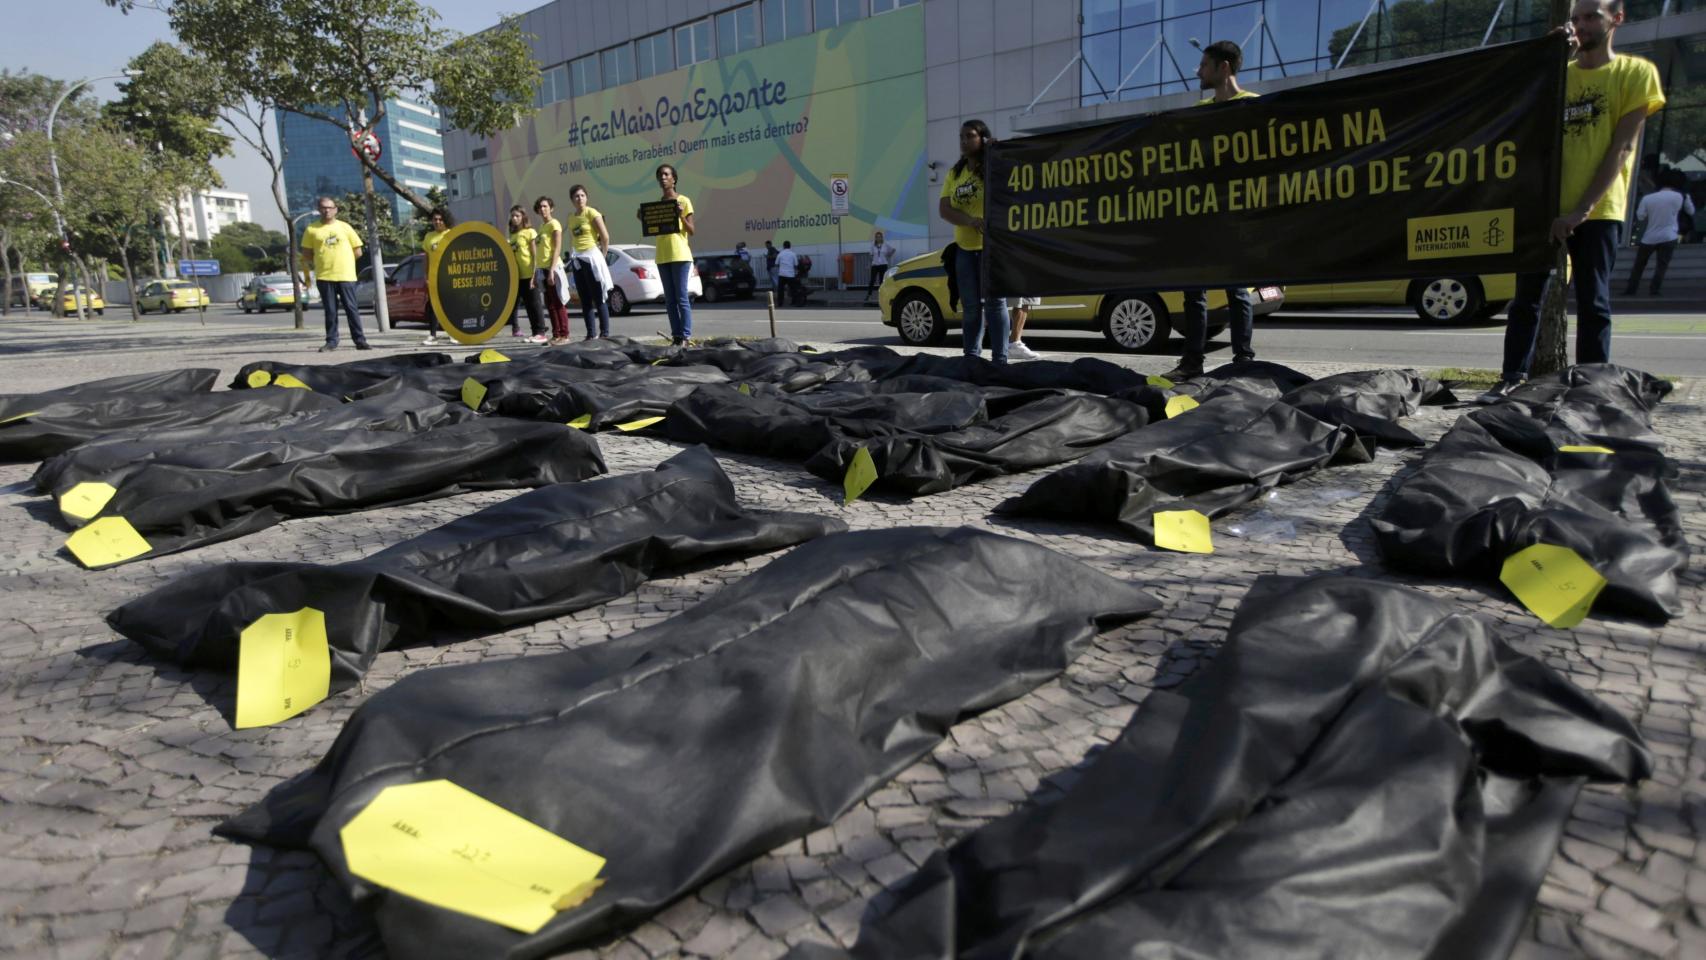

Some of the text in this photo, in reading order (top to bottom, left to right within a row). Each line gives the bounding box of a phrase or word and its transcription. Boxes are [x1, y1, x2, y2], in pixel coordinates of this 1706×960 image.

[569, 161, 582, 173] Mil
[633, 142, 677, 161] Parabéns!
[679, 139, 708, 154] Quem
[711, 131, 736, 148] mais
[738, 125, 761, 143] está
[764, 116, 809, 139] dentro?
[1007, 108, 1387, 192] 40 MORTOS PELA POLÍCIA NA
[1007, 141, 1517, 232] CIDADE OLÍMPICA EM MAIO DE 2016
[1414, 225, 1470, 244] ANISTIA
[1414, 241, 1470, 253] INTERNACIONAL
[463, 263, 475, 274] FAZ
[477, 261, 498, 272] PARTE
